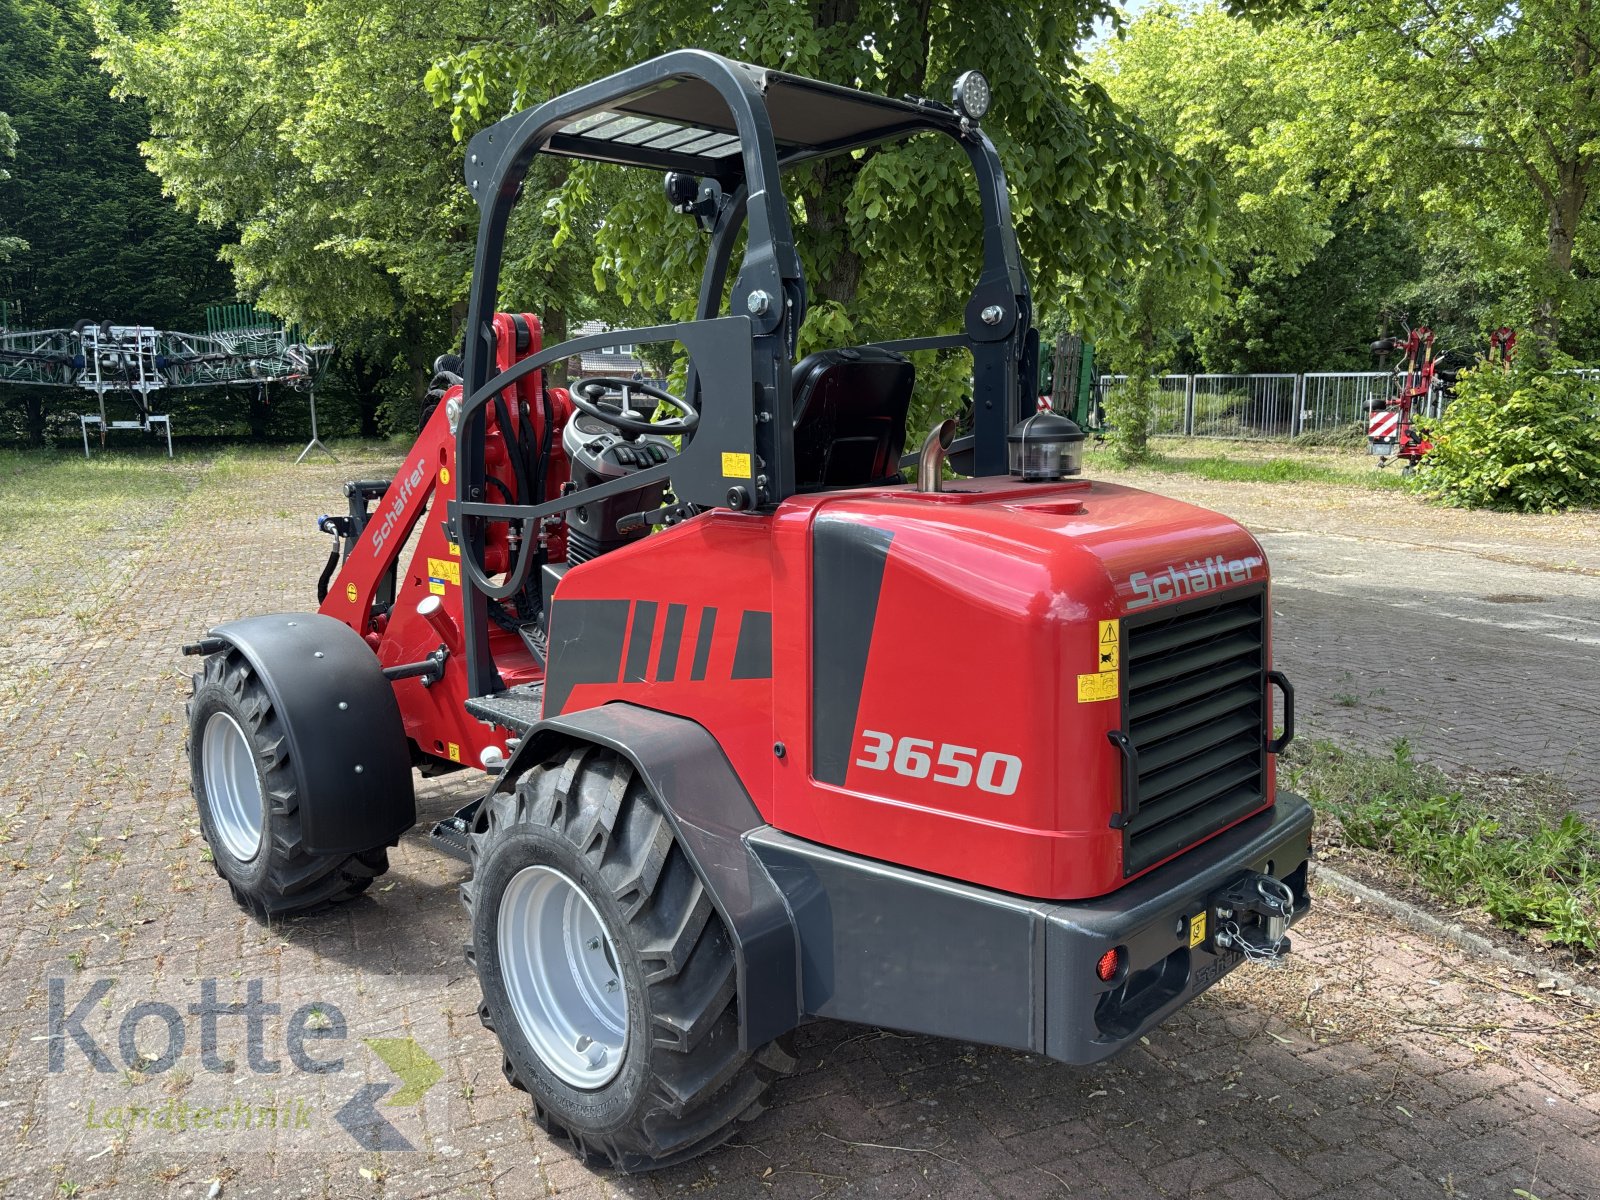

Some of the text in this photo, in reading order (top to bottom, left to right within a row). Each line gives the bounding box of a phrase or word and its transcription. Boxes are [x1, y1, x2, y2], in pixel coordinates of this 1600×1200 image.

[372, 458, 425, 557] Schäffer
[1126, 555, 1263, 609] Schäffer
[856, 729, 1022, 796] 3650
